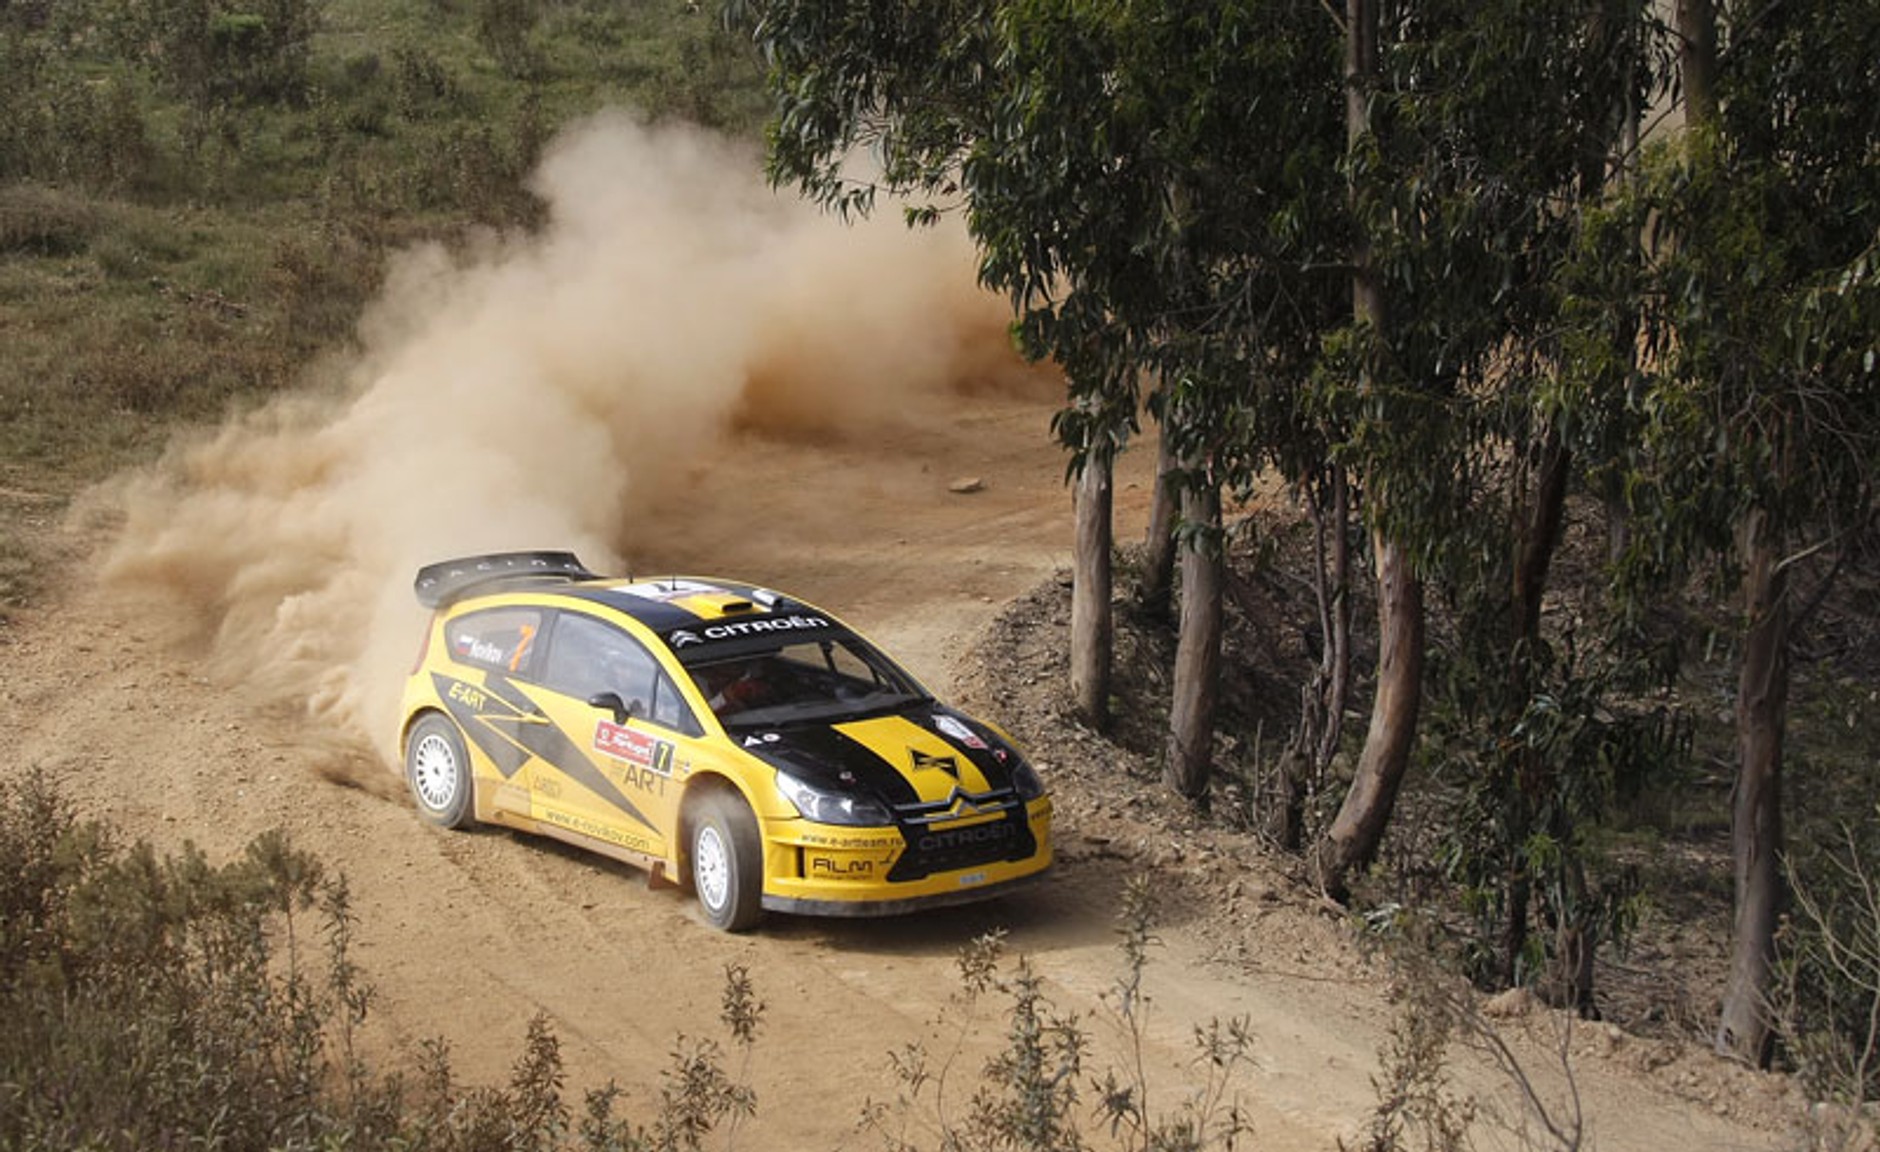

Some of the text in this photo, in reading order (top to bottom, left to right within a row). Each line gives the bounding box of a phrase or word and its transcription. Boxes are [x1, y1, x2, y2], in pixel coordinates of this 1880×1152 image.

[509, 624, 535, 672] 7
[449, 682, 487, 711] E-ART
[657, 743, 669, 771] 7
[623, 764, 667, 797] ART
[546, 808, 650, 849] www.e-novikov.com
[813, 857, 873, 874] ALM
